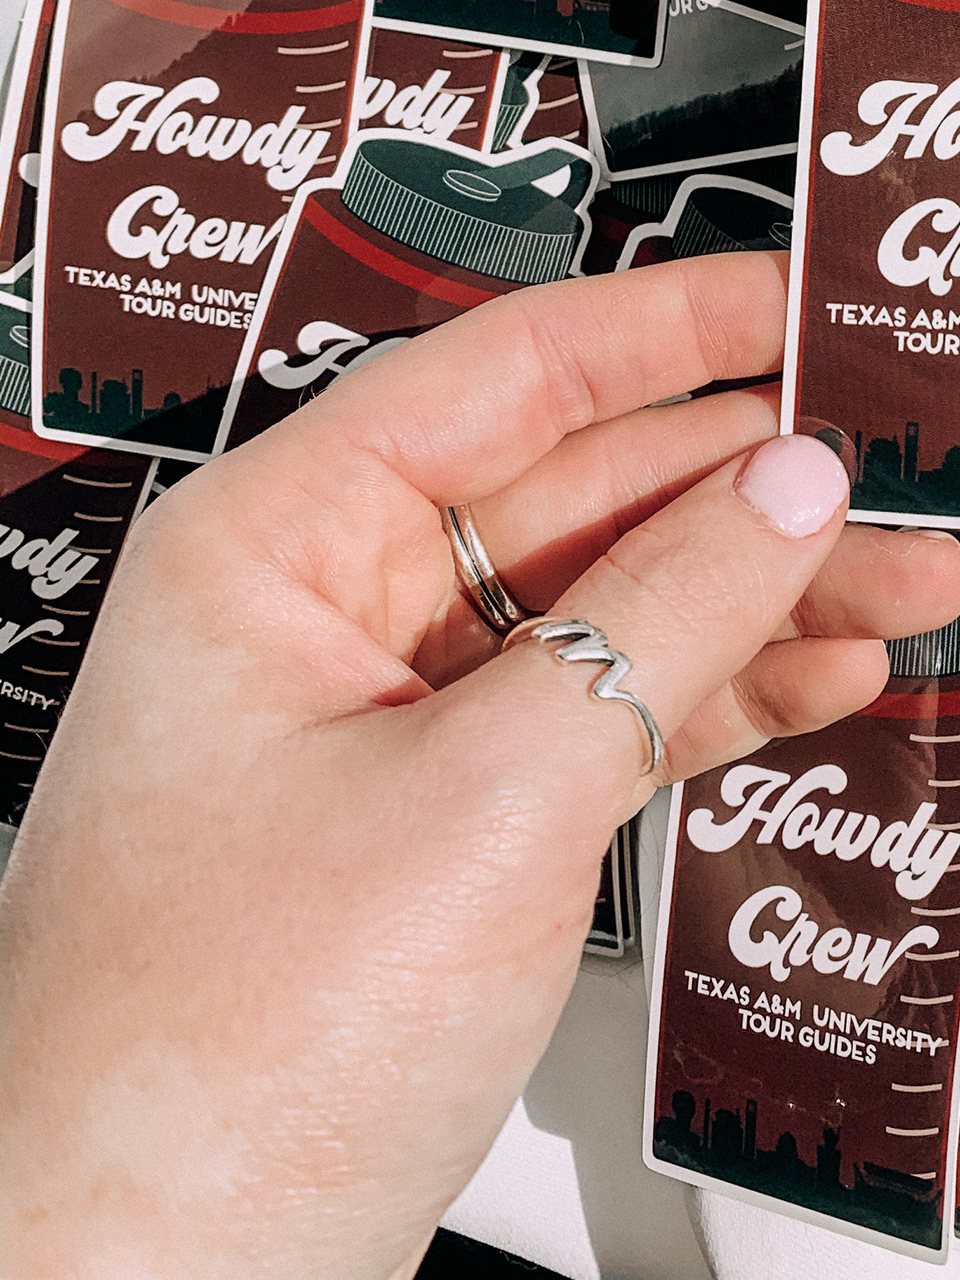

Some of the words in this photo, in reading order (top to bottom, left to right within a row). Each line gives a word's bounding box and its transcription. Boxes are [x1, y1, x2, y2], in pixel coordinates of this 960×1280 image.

[62, 77, 331, 190] Howdy
[107, 185, 288, 269] Crew
[64, 265, 131, 291] TEXAS
[134, 275, 181, 300] A&M
[119, 294, 177, 320] TOUR
[179, 300, 255, 331] GUIDES
[826, 302, 905, 328] TEXAS
[893, 329, 960, 356] TOUR
[728, 885, 939, 985] Crew
[684, 971, 751, 1006] TEXAS
[753, 990, 801, 1017] A&M
[812, 1003, 943, 1057] UNIVERSITY
[738, 1008, 795, 1043] TOUR
[798, 1027, 877, 1065] GUIDES
